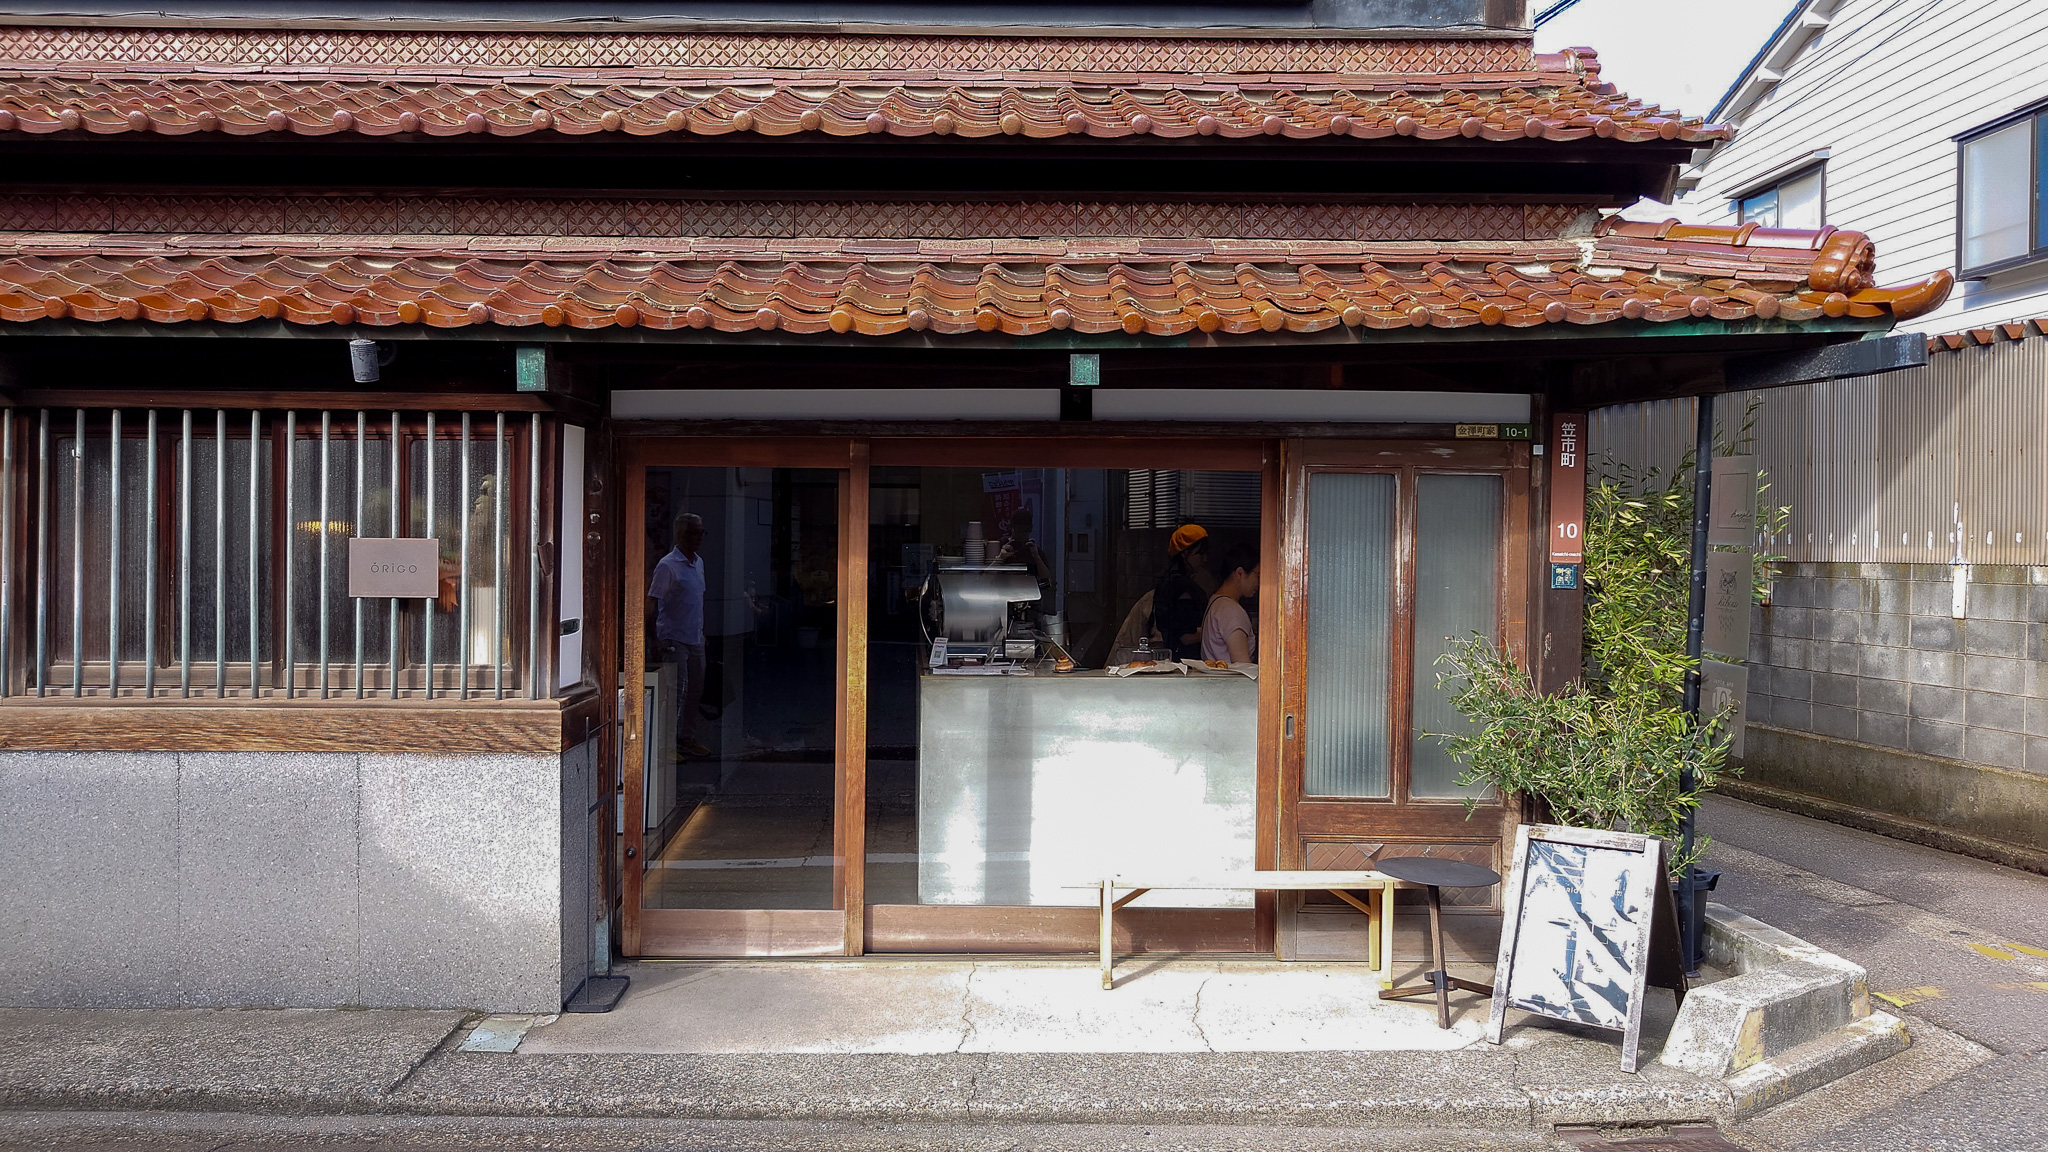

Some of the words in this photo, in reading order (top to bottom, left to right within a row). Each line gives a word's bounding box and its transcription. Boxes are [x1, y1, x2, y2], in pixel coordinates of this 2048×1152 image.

[1505, 427, 1528, 437] 10-1
[1561, 422, 1576, 467] 笠市町
[1557, 522, 1578, 539] 10
